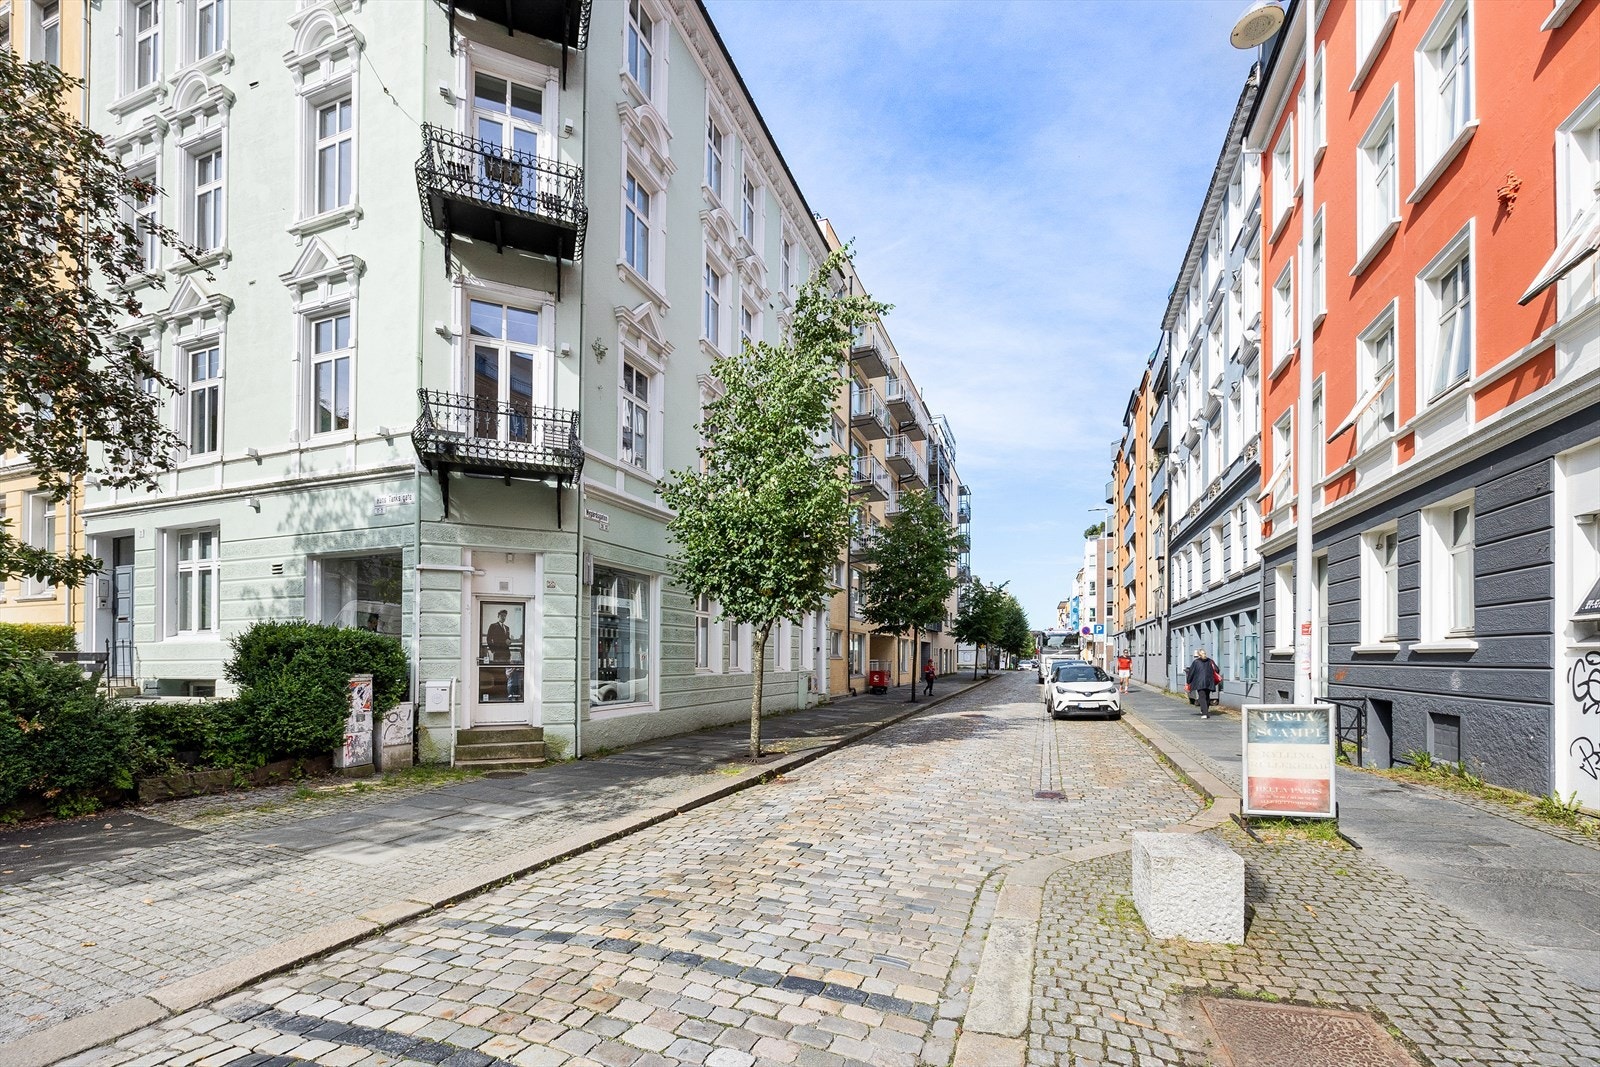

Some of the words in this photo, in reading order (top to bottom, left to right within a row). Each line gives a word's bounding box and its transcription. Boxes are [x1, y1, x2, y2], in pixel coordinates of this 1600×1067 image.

[1263, 712, 1315, 722] PASTA
[1257, 728, 1321, 738] SCAMPI
[1255, 786, 1288, 794] BELLA
[1290, 787, 1322, 795] PARIS
